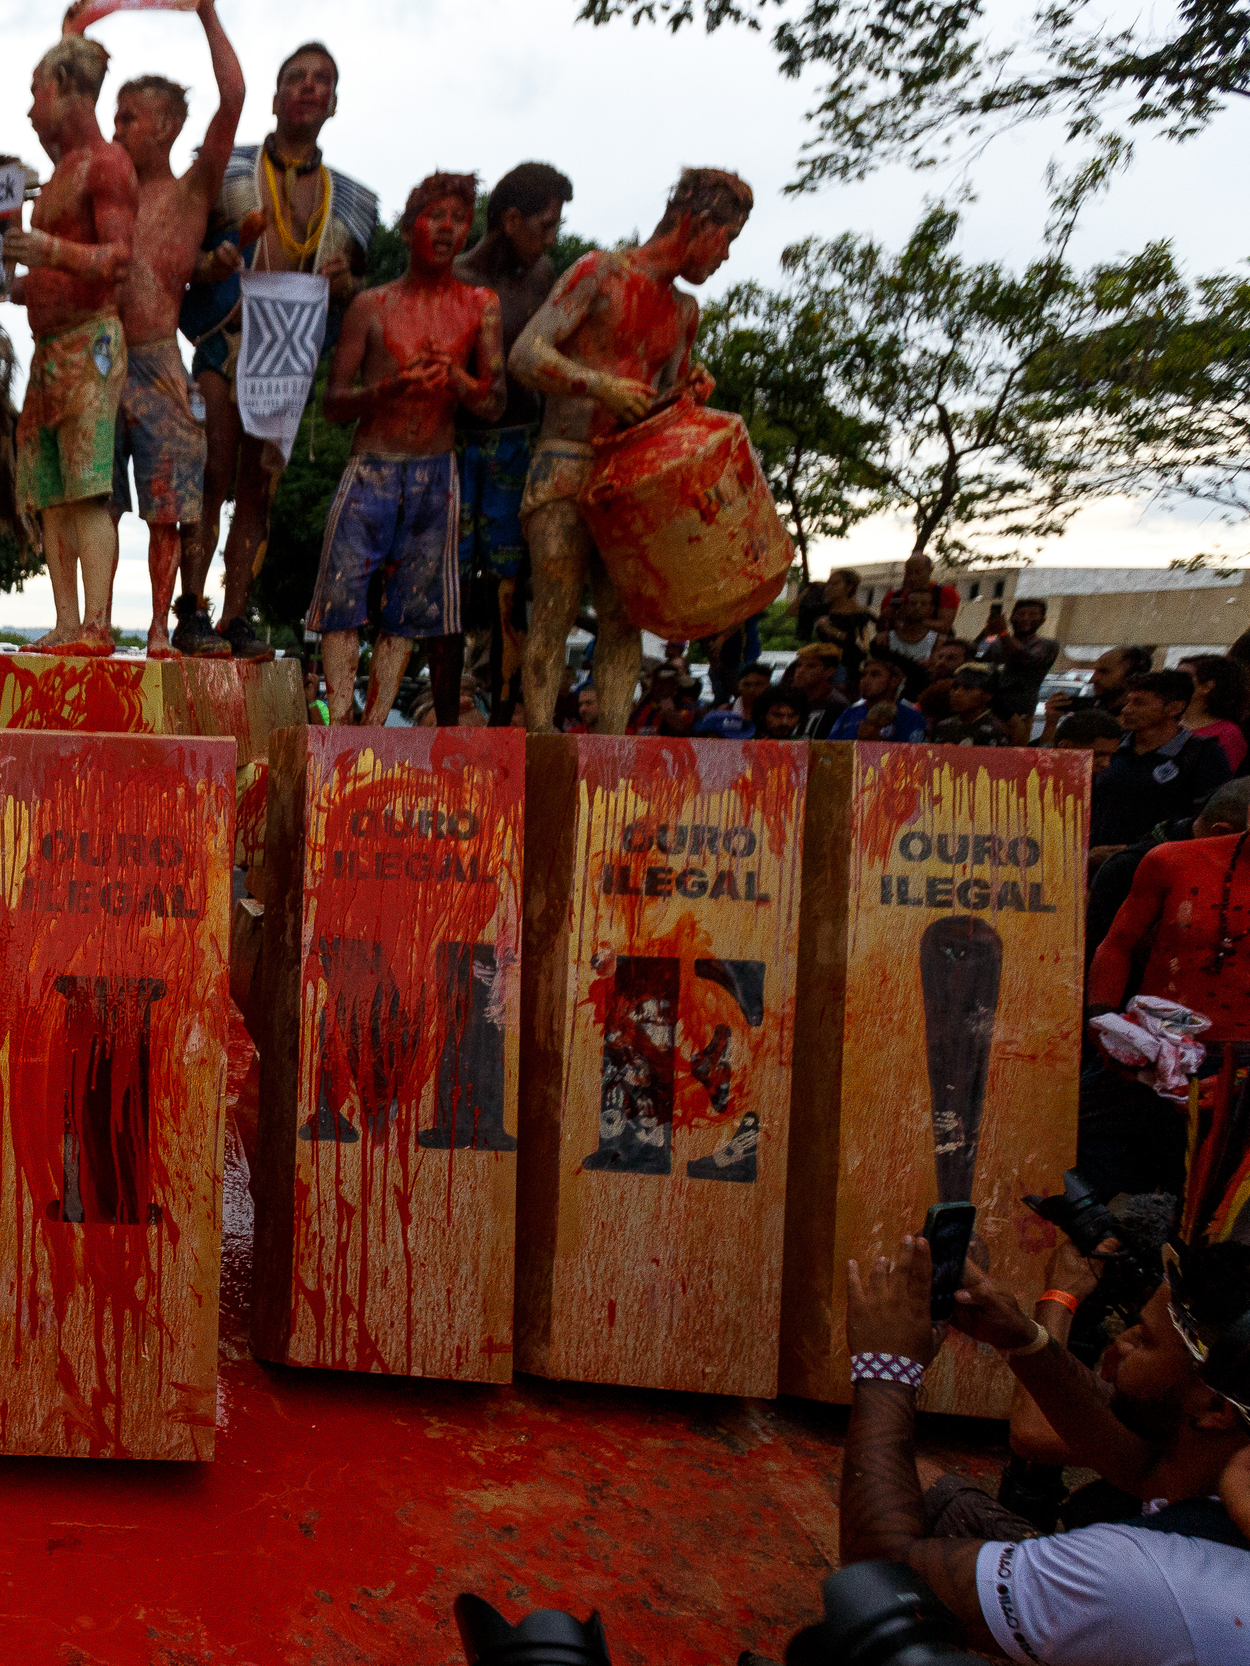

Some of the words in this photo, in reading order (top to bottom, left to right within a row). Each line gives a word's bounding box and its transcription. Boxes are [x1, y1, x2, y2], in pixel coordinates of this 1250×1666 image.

[350, 807, 480, 841] OURO
[621, 822, 757, 858] OURO
[42, 829, 184, 869] OURO
[333, 849, 496, 884] ILEGAL
[898, 830, 1040, 869] OURO
[21, 876, 198, 918] ILEGAL
[602, 863, 772, 903] ILEGAL
[879, 874, 1057, 913] ILEGAL
